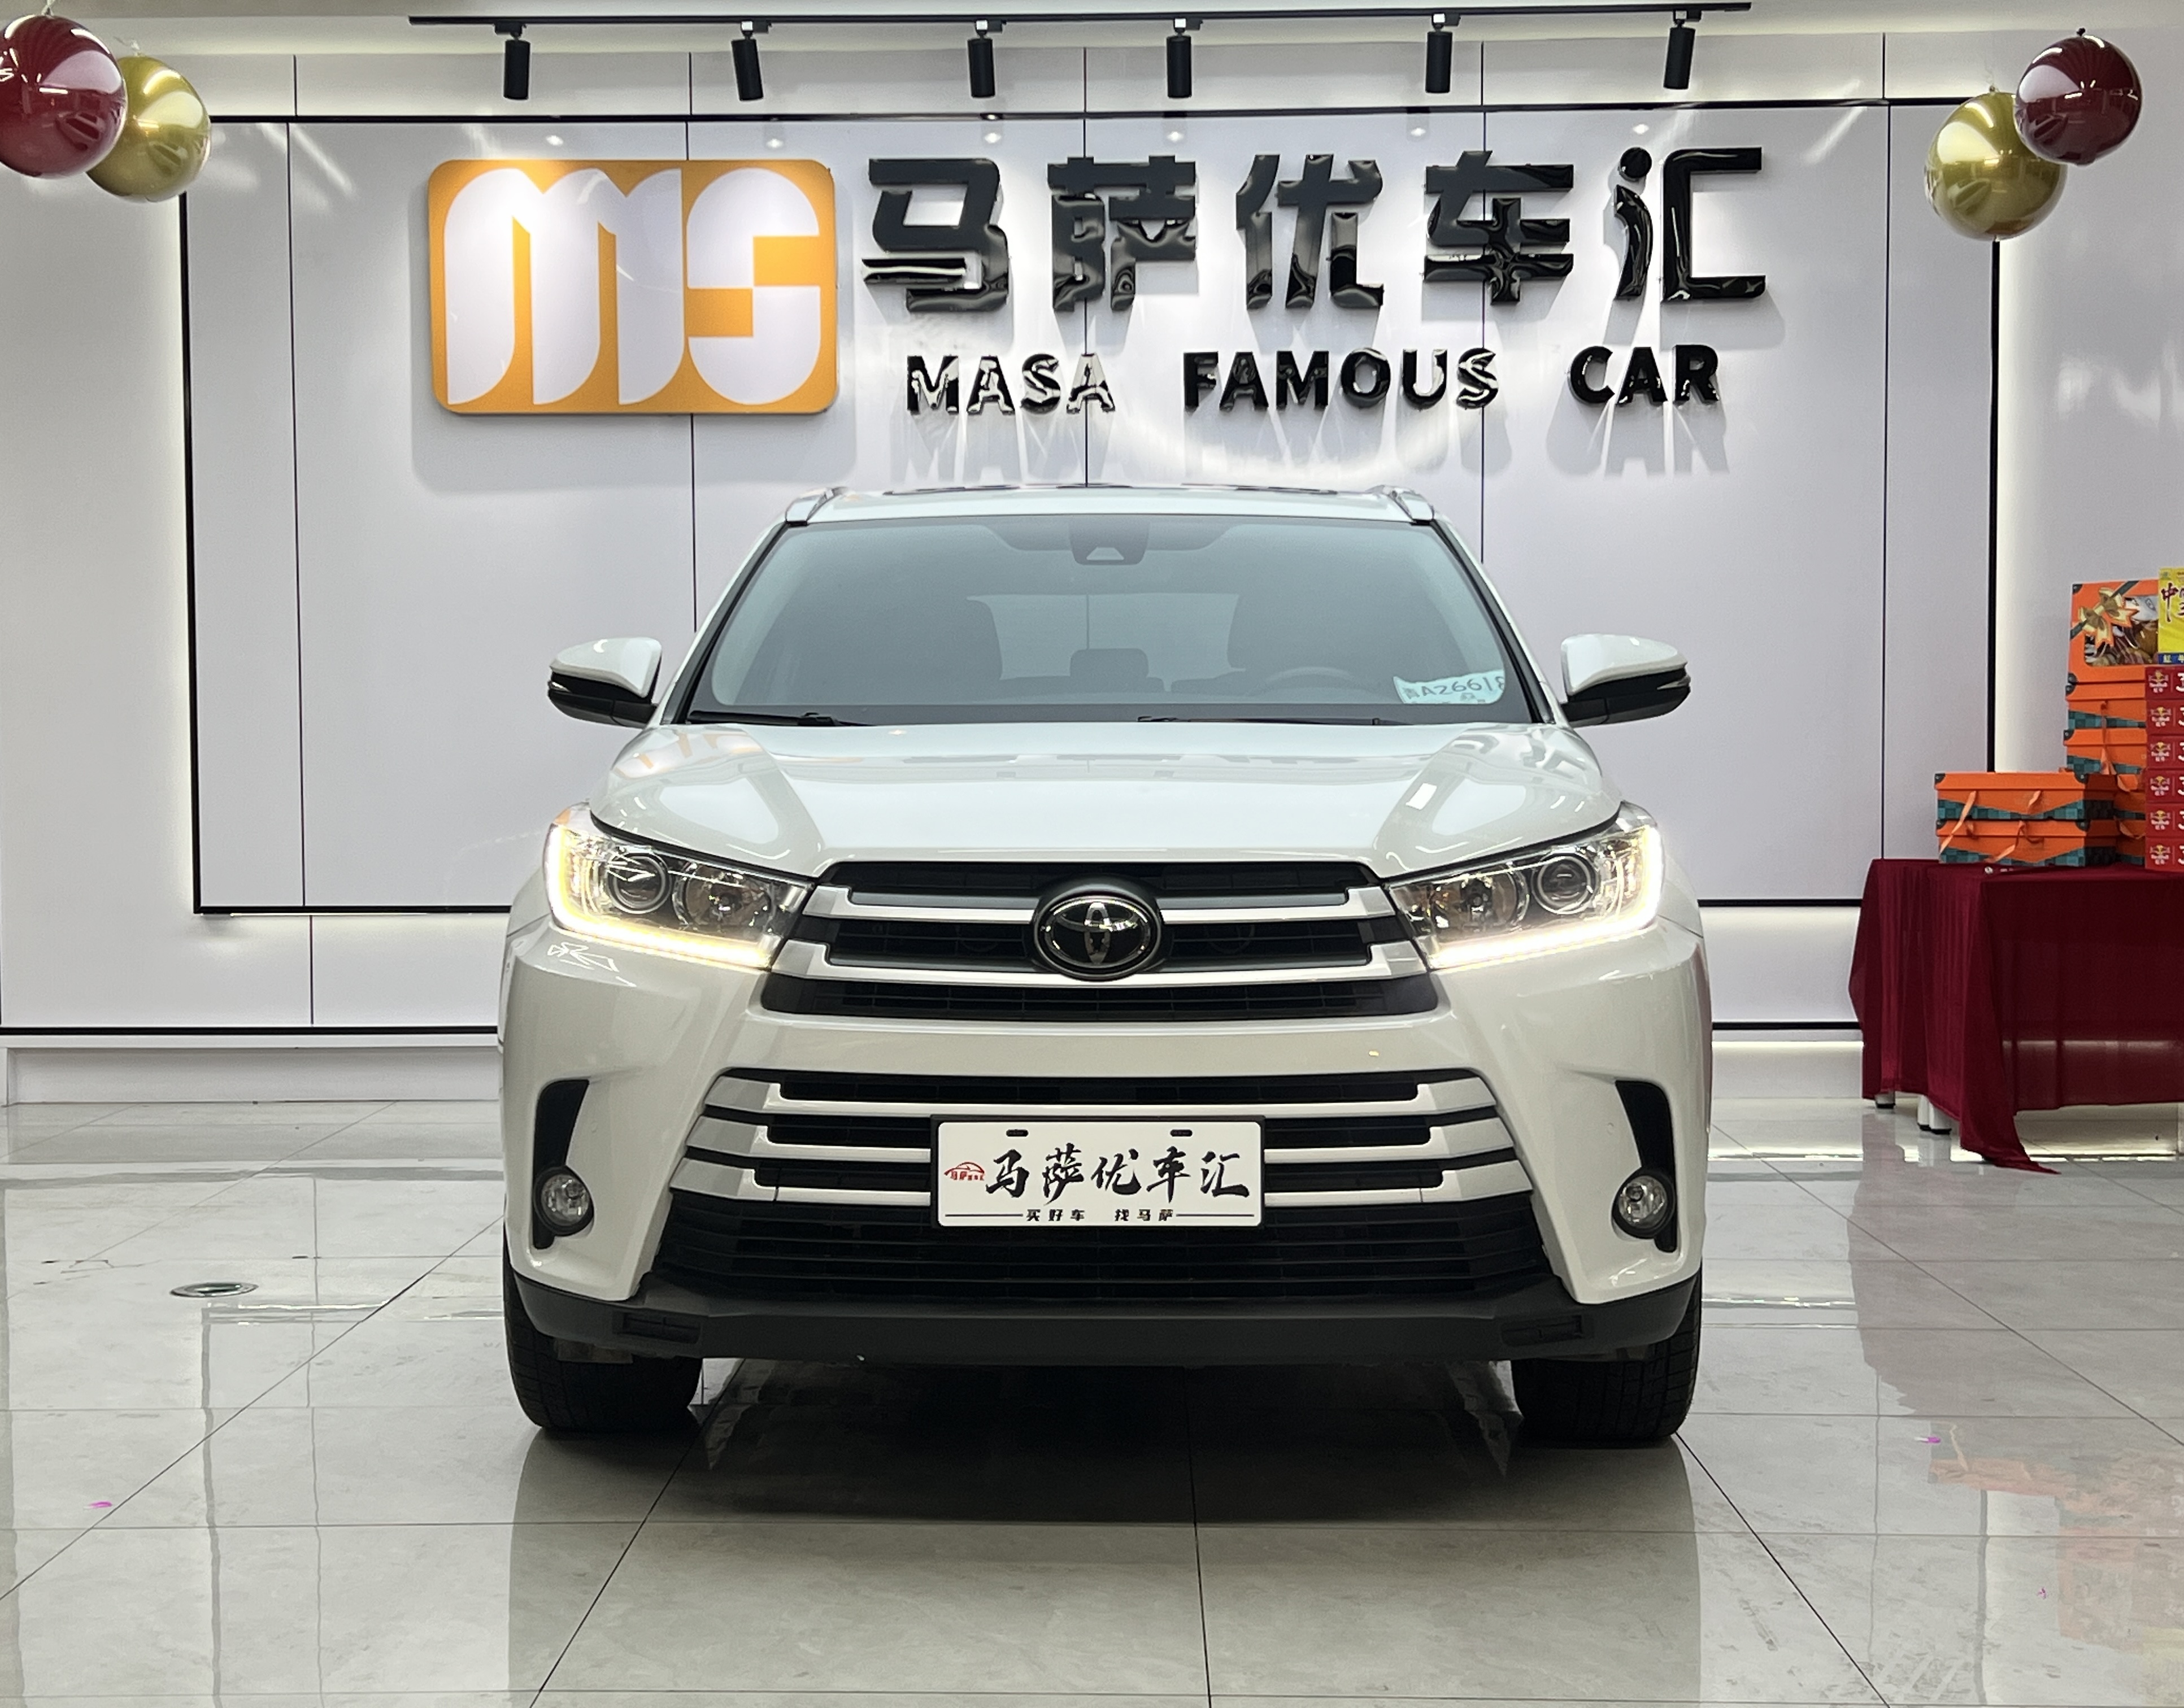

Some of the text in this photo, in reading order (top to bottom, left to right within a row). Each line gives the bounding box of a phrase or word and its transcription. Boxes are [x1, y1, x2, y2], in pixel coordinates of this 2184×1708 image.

[862, 146, 1766, 312] 马萨优车汇
[906, 345, 1720, 415] MASA FAMOUS CAR
[985, 1143, 1250, 1205] 马萨优车汇
[1026, 1209, 1174, 1221] 买好车 找马萨
